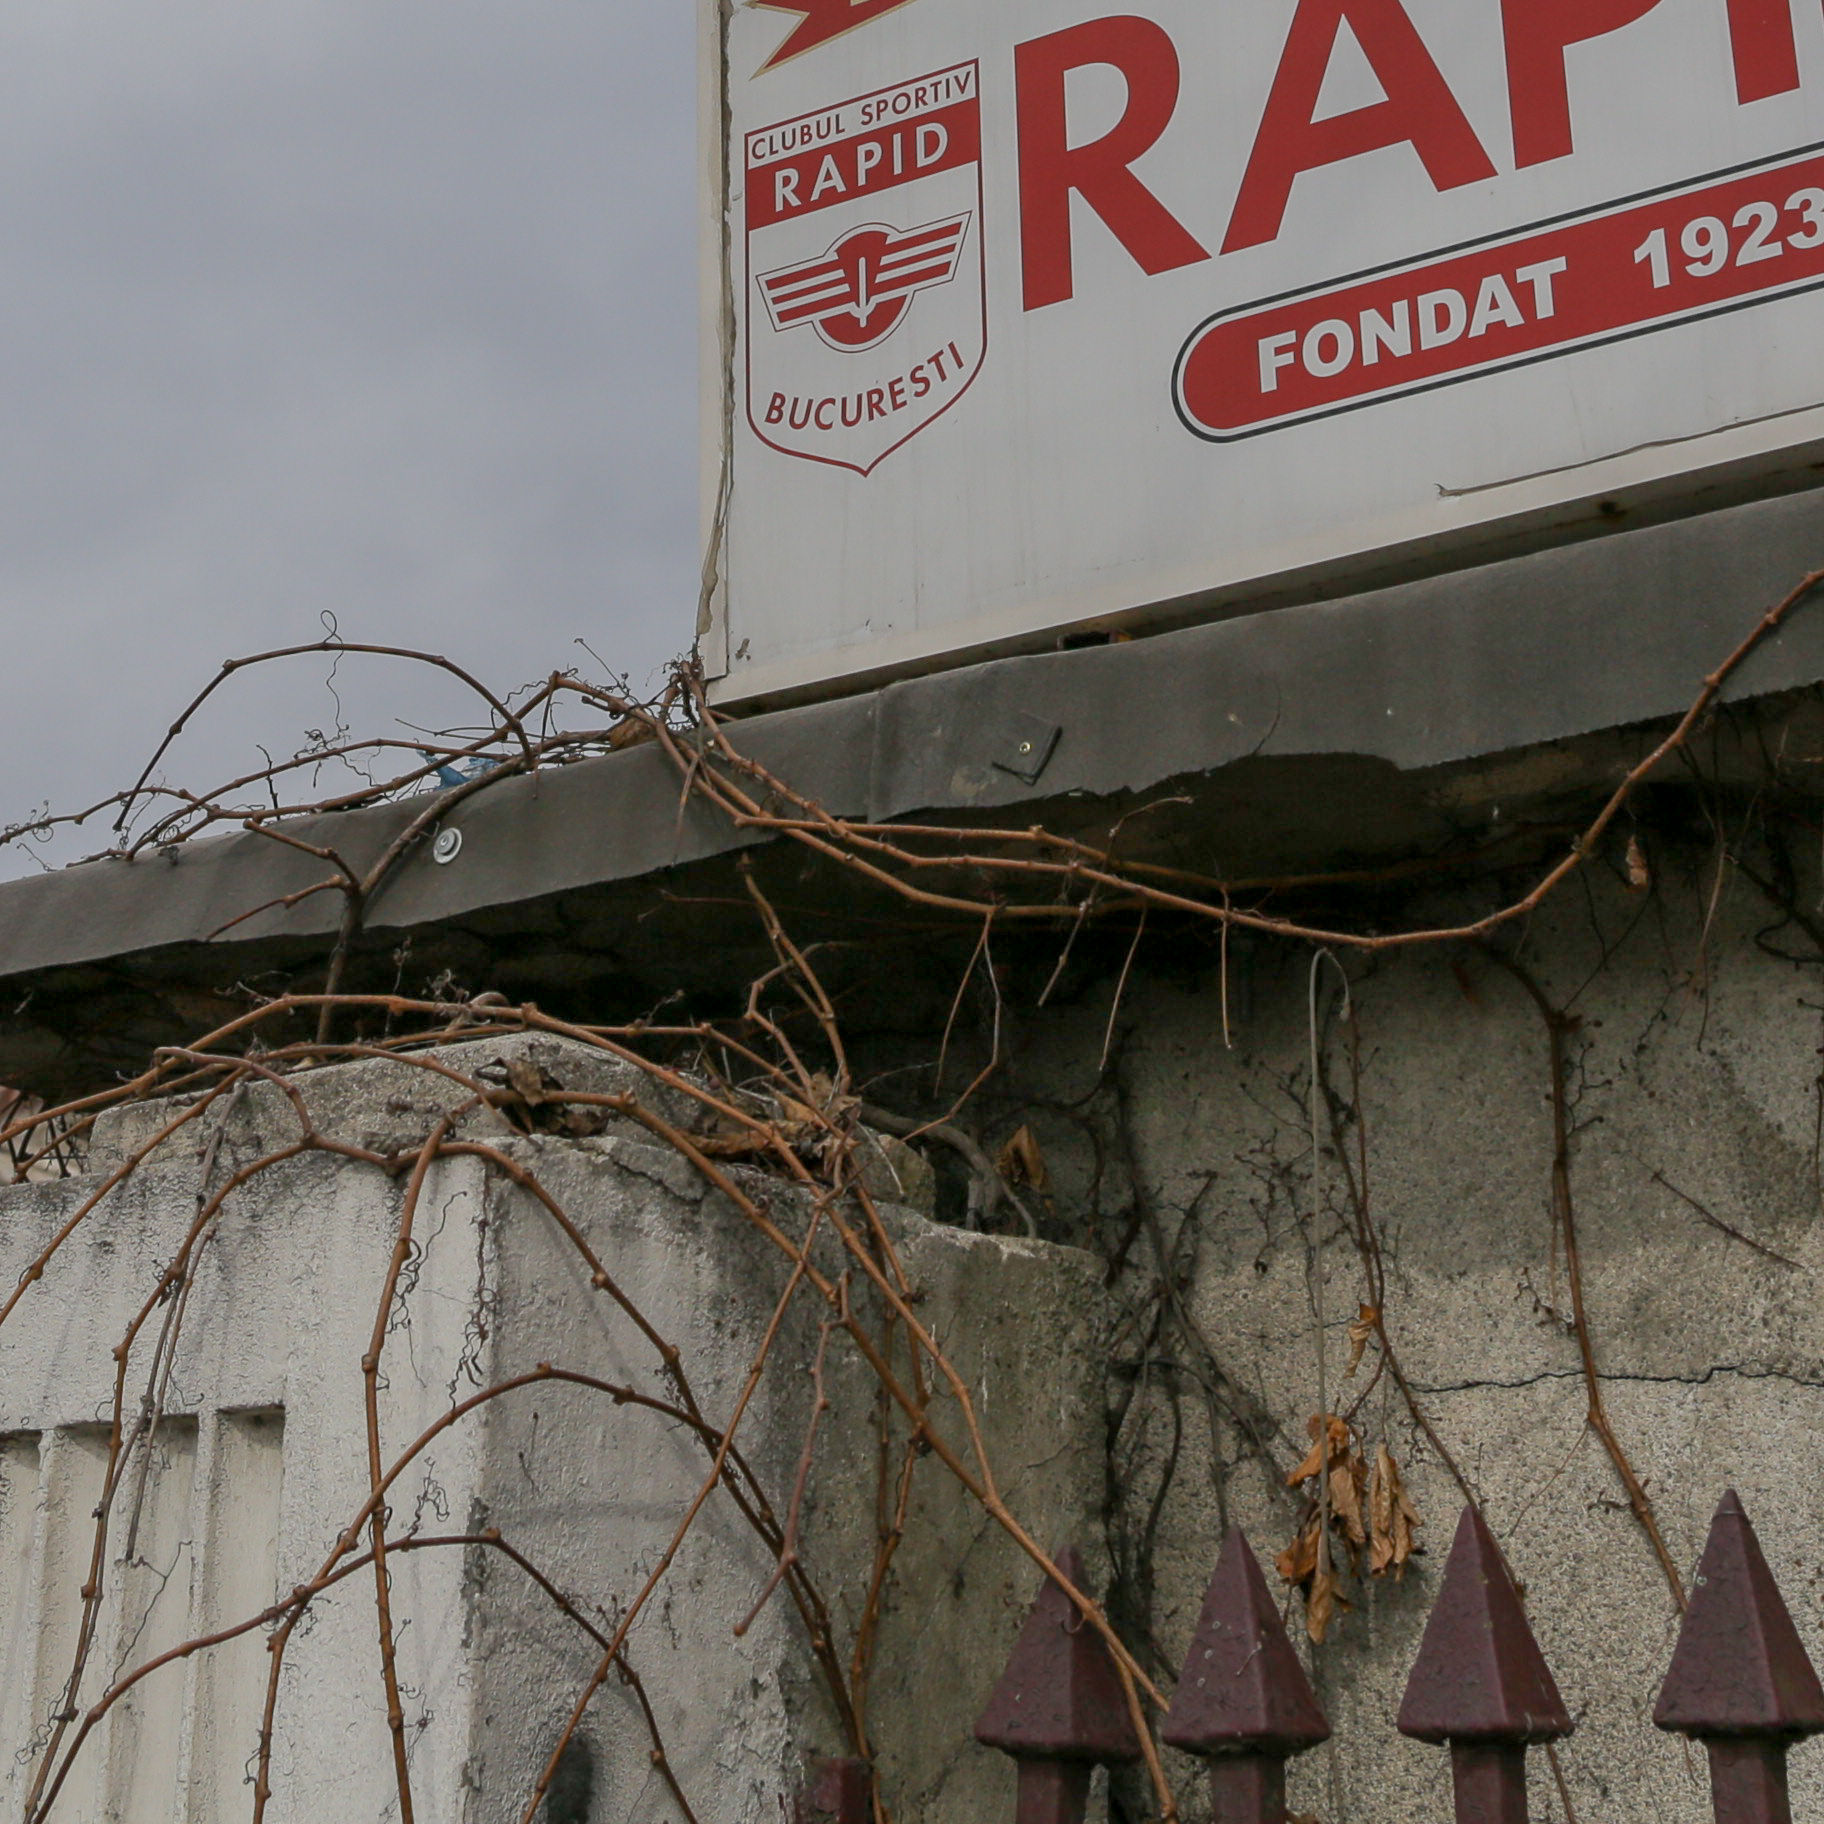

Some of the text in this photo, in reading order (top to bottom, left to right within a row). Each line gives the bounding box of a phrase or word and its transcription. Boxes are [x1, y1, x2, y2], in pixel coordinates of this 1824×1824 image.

[751, 70, 972, 160] CLUBUL SPORTIV
[774, 121, 949, 212] RAPID
[1256, 255, 1568, 394] FONDAT
[763, 340, 965, 431] BUCURESTI
